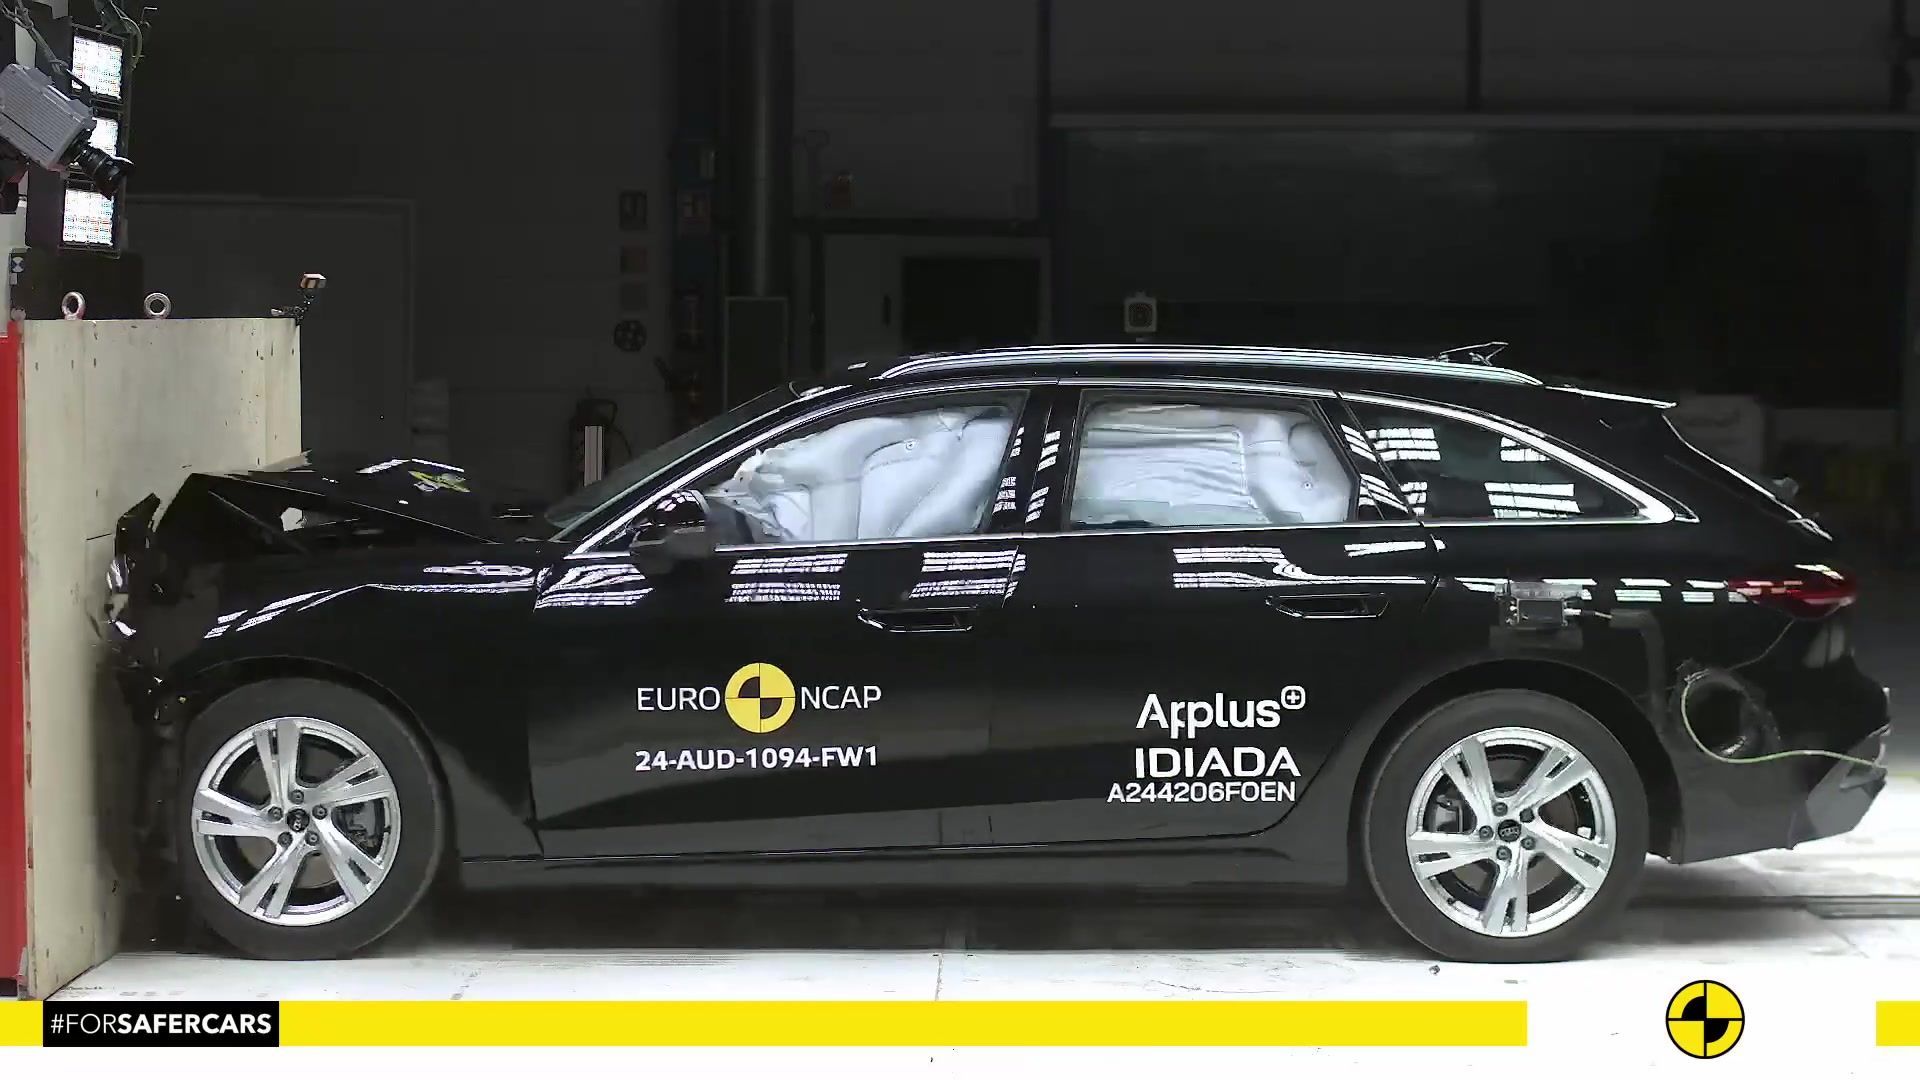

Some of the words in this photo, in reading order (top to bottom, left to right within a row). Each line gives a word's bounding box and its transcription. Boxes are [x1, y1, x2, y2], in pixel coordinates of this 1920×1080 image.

[637, 686, 721, 711] EURO
[801, 685, 882, 710] NCAP
[635, 745, 877, 771] 24-AUD-1094-FW1
[1135, 746, 1302, 779] IDIADA
